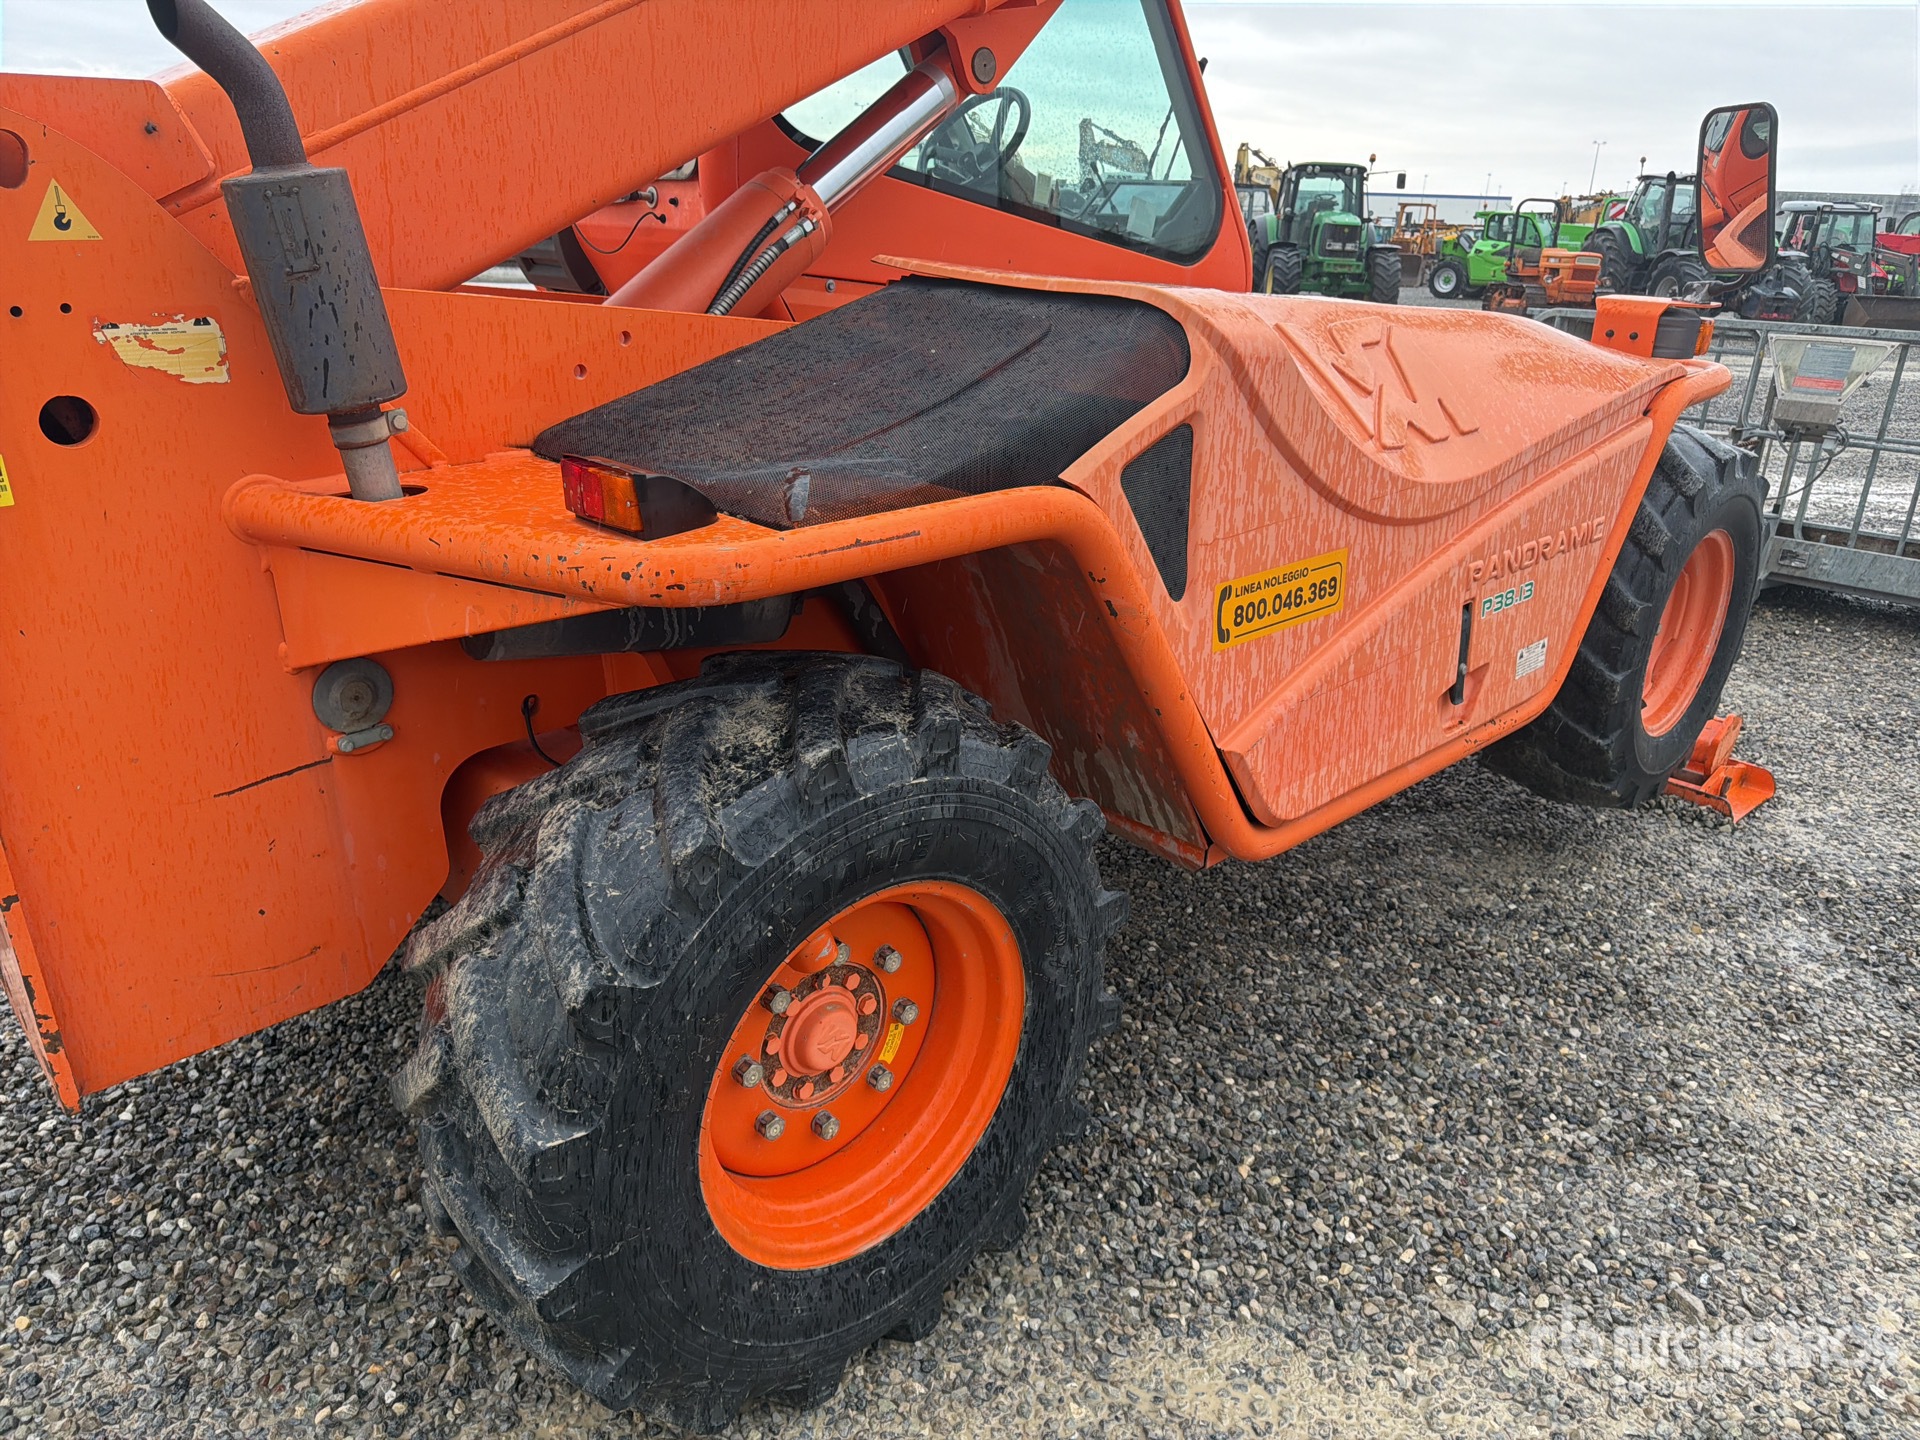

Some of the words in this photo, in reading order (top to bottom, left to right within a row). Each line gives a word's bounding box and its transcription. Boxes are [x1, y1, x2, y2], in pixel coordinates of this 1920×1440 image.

[1466, 516, 1606, 591] PANORAMIC
[1233, 576, 1338, 628] 800.046.369
[1235, 581, 1262, 598] LINEA
[1263, 567, 1309, 590] NOLEGGIO
[1481, 580, 1535, 619] P38.13
